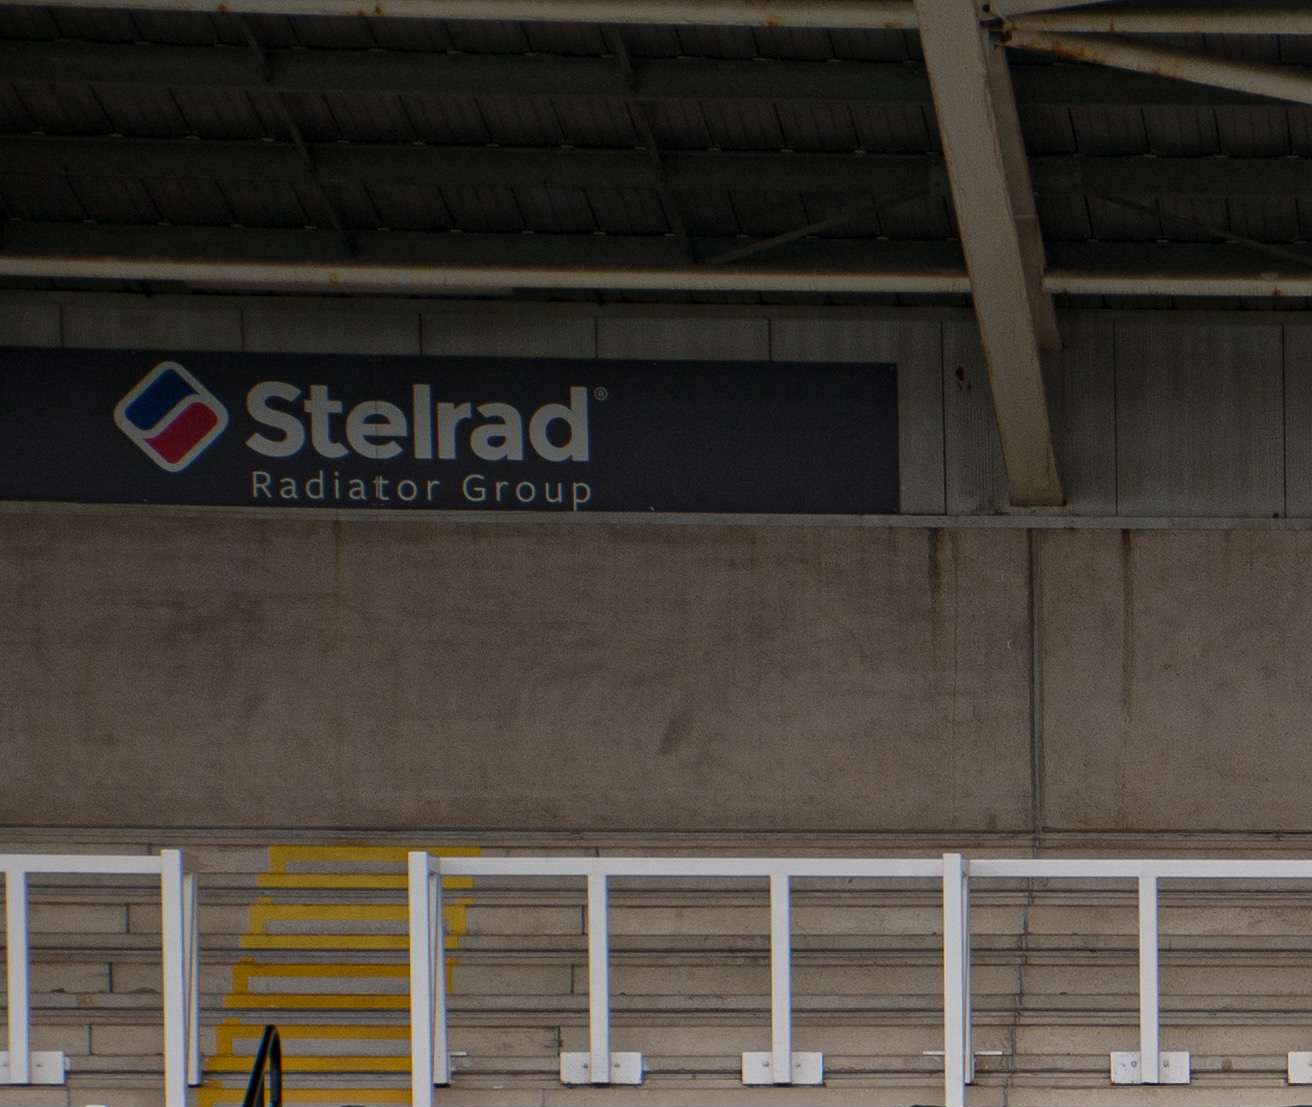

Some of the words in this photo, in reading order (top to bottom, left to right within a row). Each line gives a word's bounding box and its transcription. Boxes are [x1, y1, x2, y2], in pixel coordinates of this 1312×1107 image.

[244, 381, 590, 463] Stelrad
[251, 470, 440, 502] Radiator
[461, 473, 593, 512] Group
